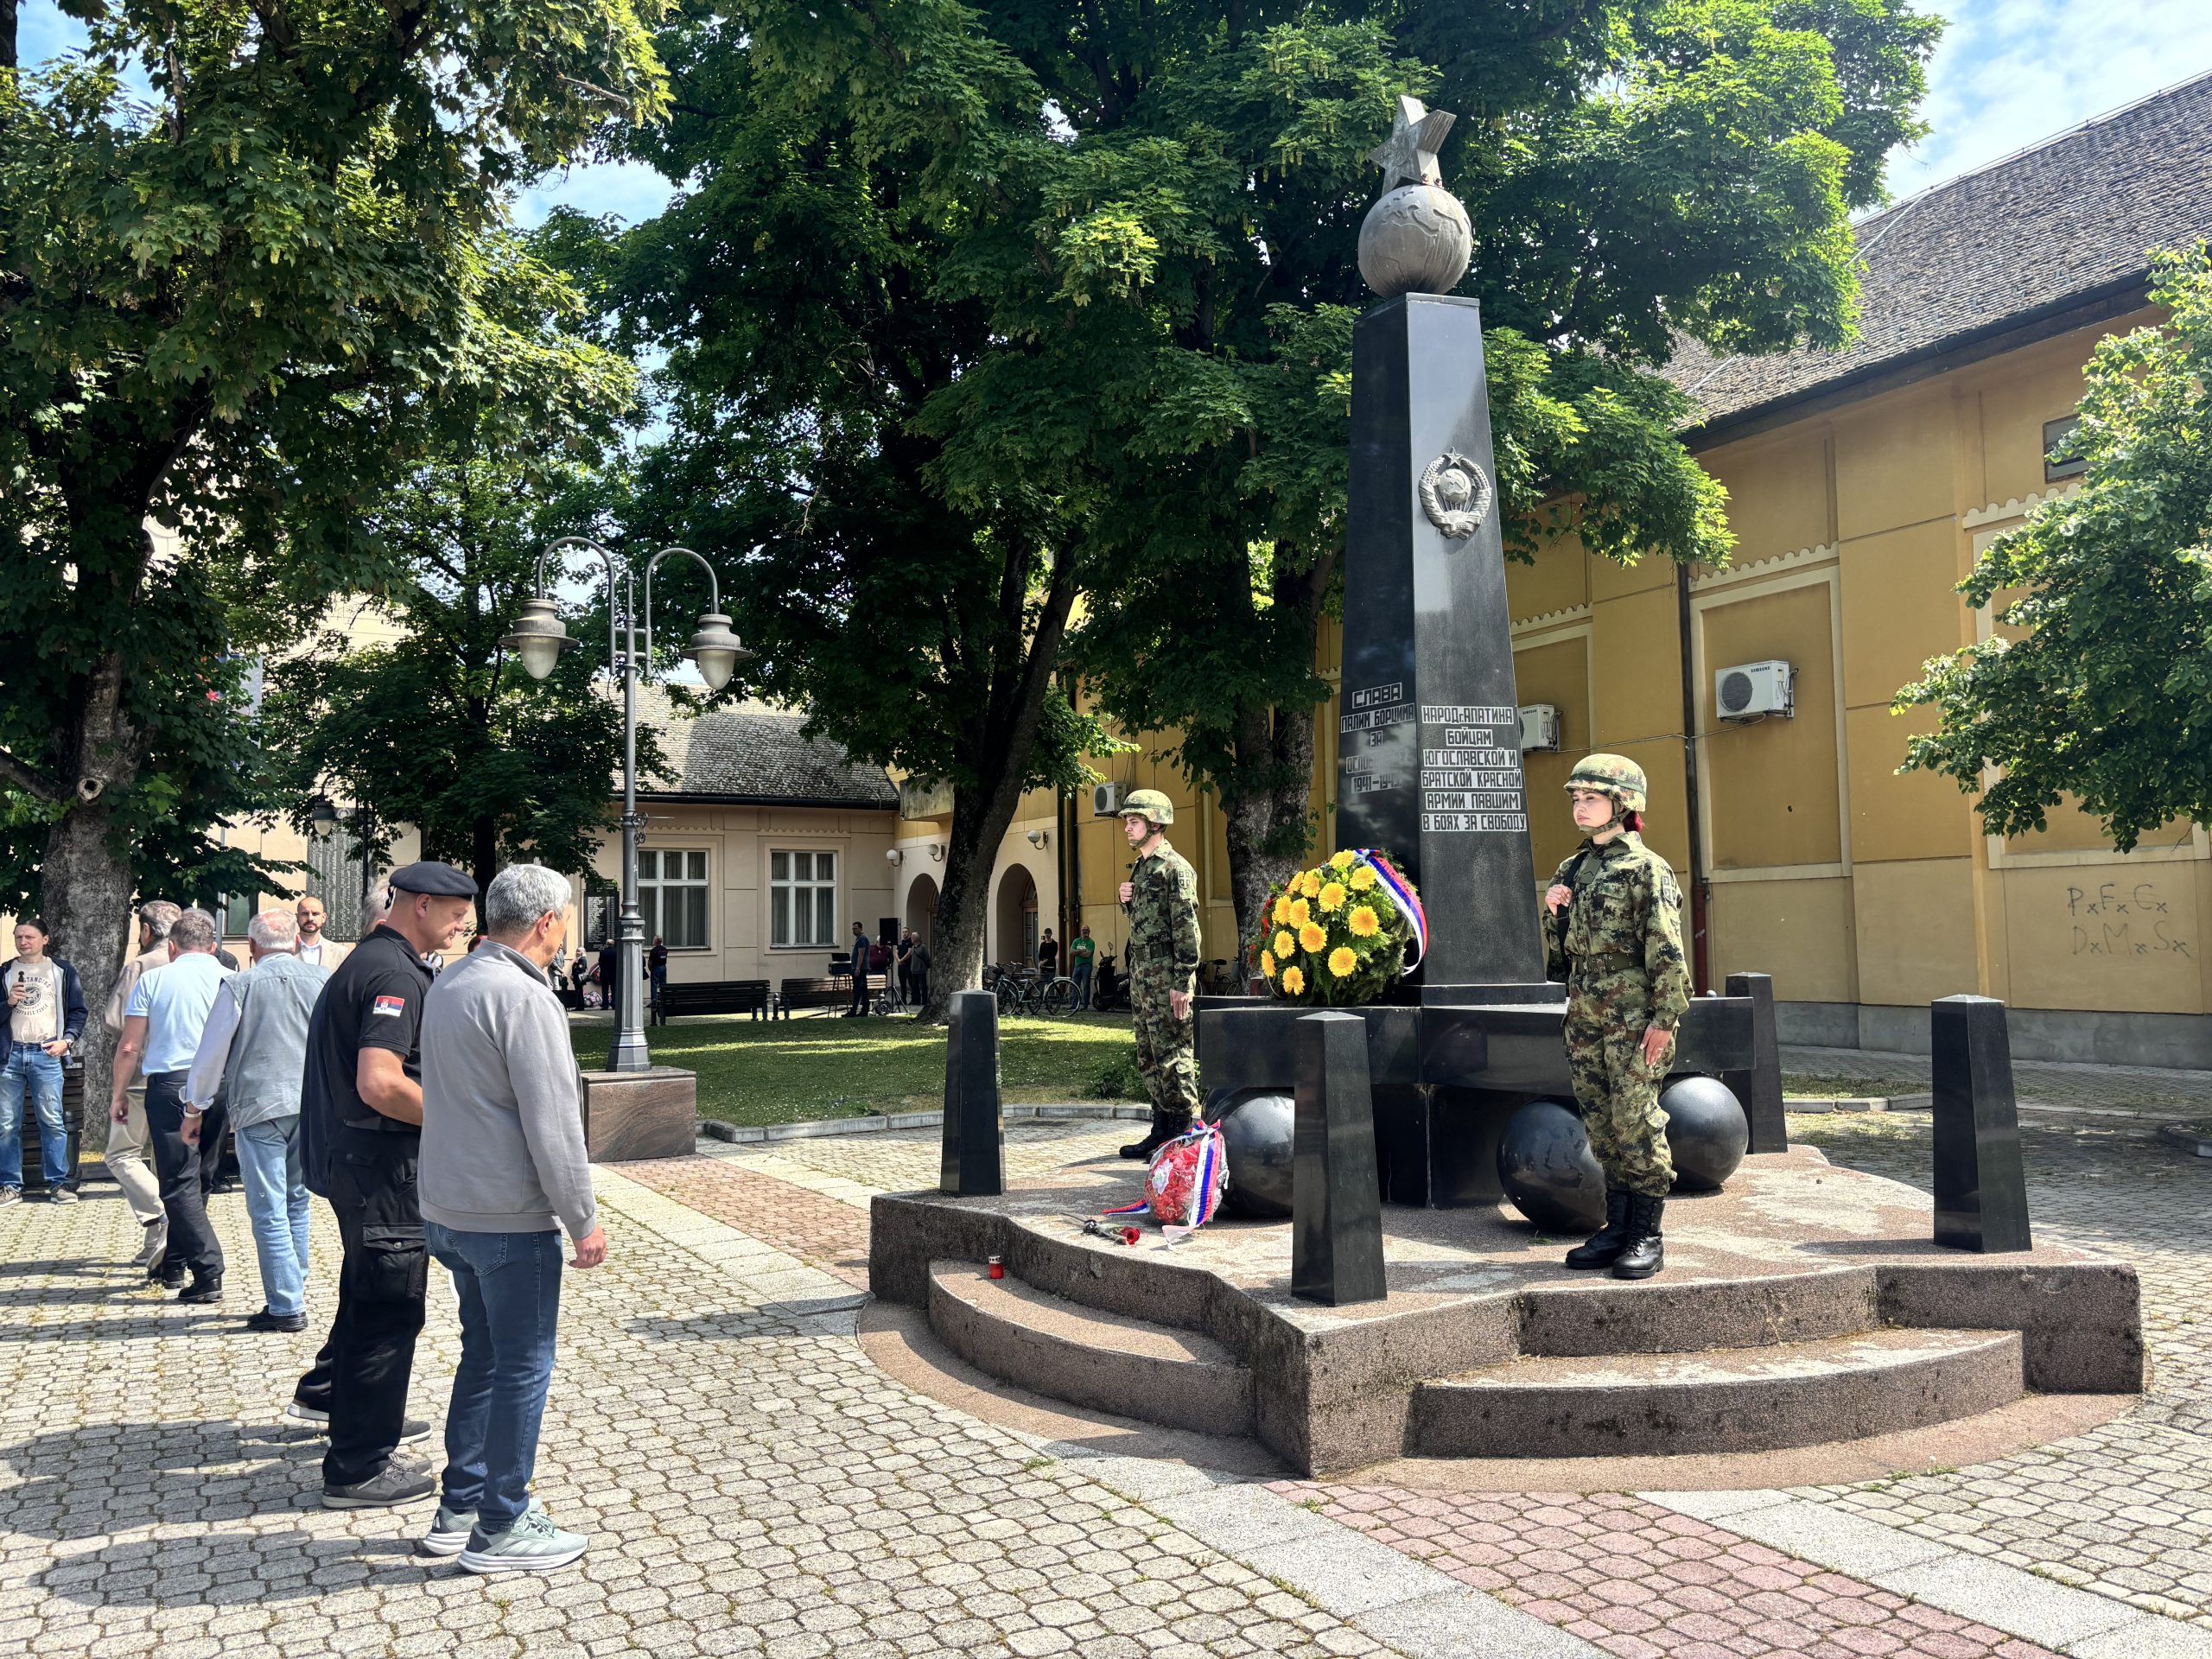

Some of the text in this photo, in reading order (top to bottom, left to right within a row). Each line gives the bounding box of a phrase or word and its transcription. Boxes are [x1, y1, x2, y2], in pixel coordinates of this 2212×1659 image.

[1353, 683, 1401, 707] СЛАВА
[1342, 704, 1414, 733] ПАЛИМ БОРЦИМА
[1370, 731, 1382, 748] ЗА
[1447, 727, 1492, 746] БОЙЦАМ
[1425, 747, 1516, 766] ЮГОСЛАВСКОЙ И
[1422, 769, 1521, 787] БРАТСКОЙ КРАСНОЙ
[1471, 793, 1519, 809] ПАВШИМ
[1423, 815, 1430, 830] В
[1434, 815, 1459, 830] БОЯХ
[1464, 815, 1477, 830] ЗА
